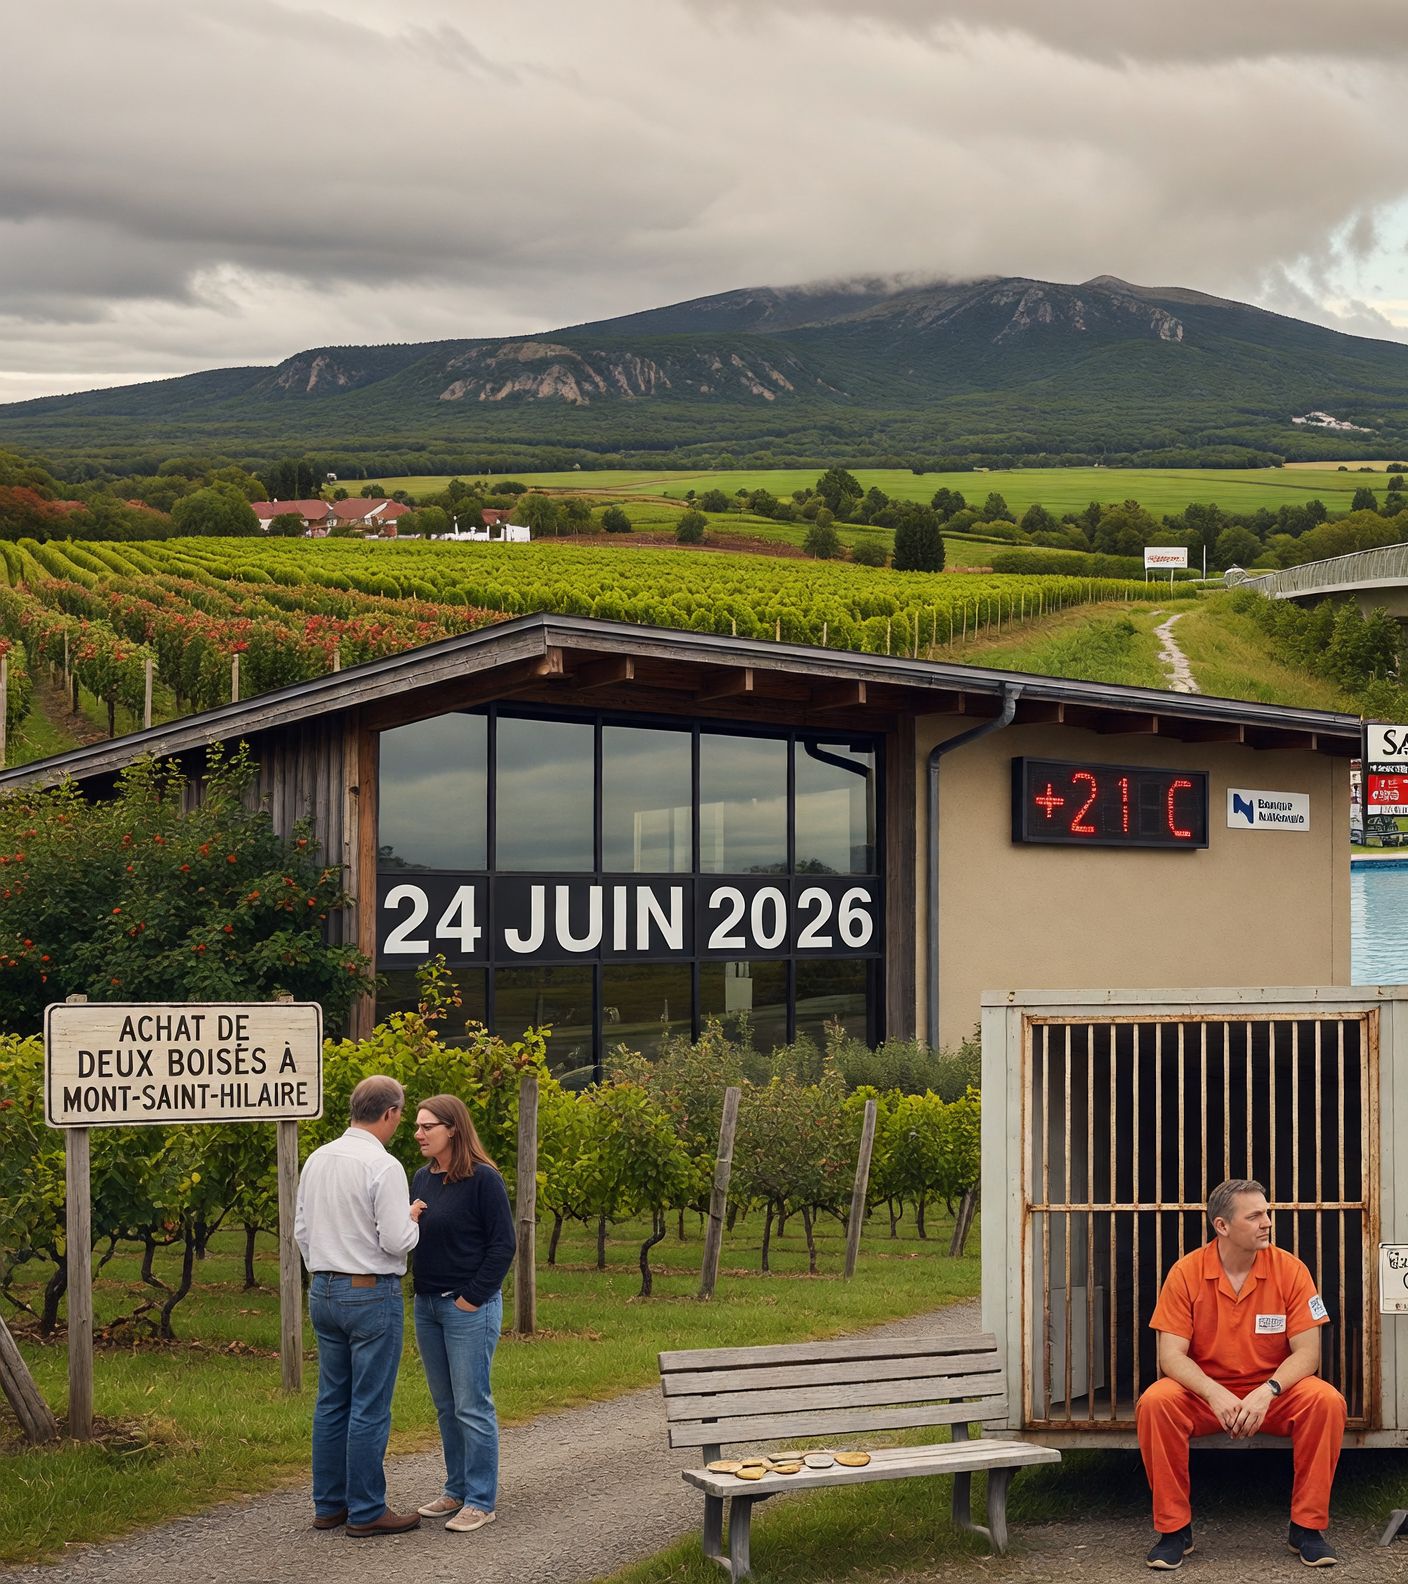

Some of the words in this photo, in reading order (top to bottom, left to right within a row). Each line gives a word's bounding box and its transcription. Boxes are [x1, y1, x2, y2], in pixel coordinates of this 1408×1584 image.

[383, 884, 482, 954] 24
[504, 884, 685, 954] JUIN
[708, 885, 874, 950] 2026
[119, 1014, 206, 1042] ACHAT
[217, 1014, 250, 1042] DE
[78, 1049, 154, 1079] DEUX
[168, 1042, 267, 1077] BOISÉS
[279, 1041, 297, 1075] À
[63, 1081, 309, 1113] MONT-SAINT-HILAIRE
